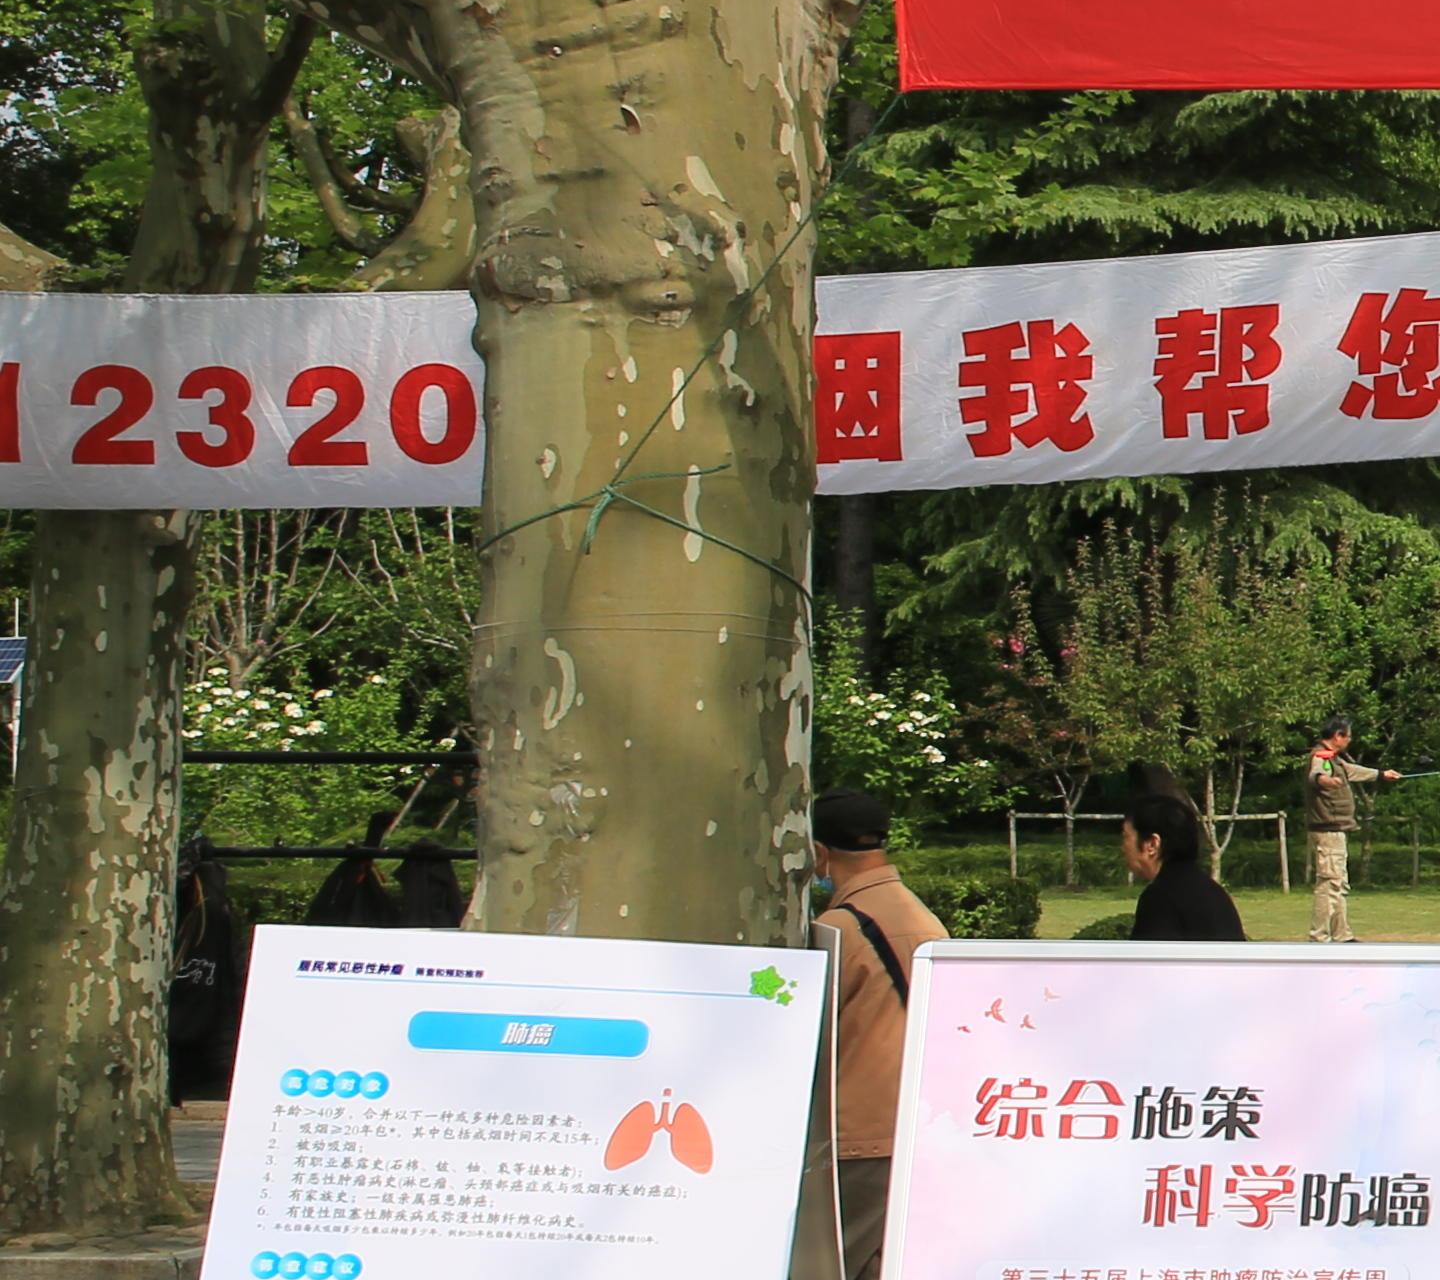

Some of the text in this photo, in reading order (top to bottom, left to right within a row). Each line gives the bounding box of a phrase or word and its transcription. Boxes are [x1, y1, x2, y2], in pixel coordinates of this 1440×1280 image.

[501, 1021, 555, 1046] 肺癌
[972, 1077, 1264, 1141] 综合施策
[1142, 1164, 1431, 1229] 科学防癌
